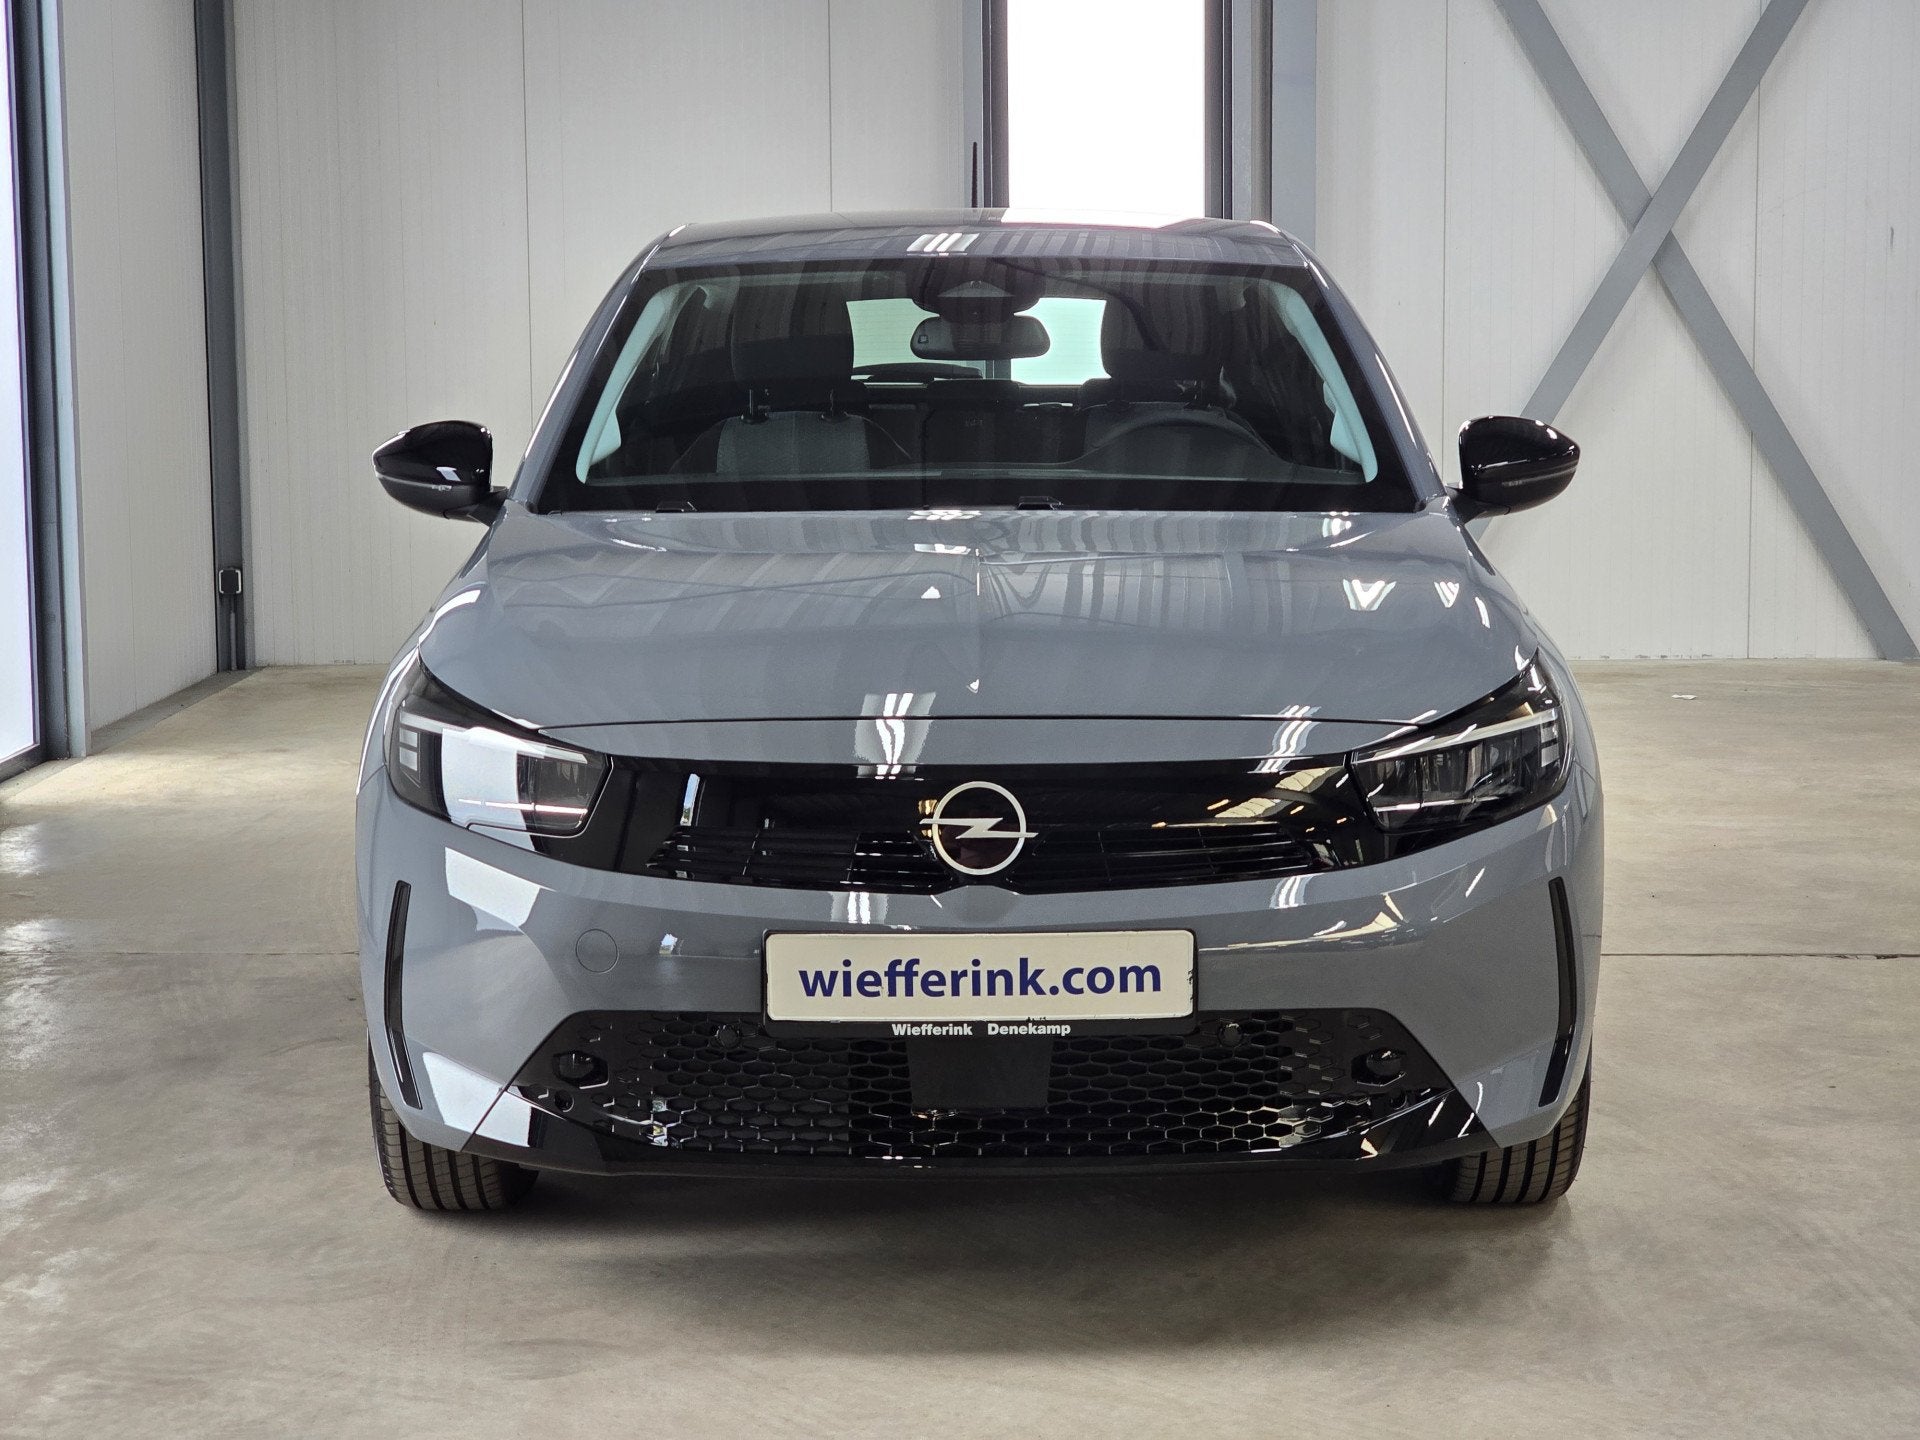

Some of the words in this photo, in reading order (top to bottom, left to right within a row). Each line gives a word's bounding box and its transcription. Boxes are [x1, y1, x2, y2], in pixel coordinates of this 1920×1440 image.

[798, 957, 1161, 998] wiefferink.com
[891, 1023, 973, 1036] Wiefferink
[987, 1022, 1072, 1037] Denekamp
